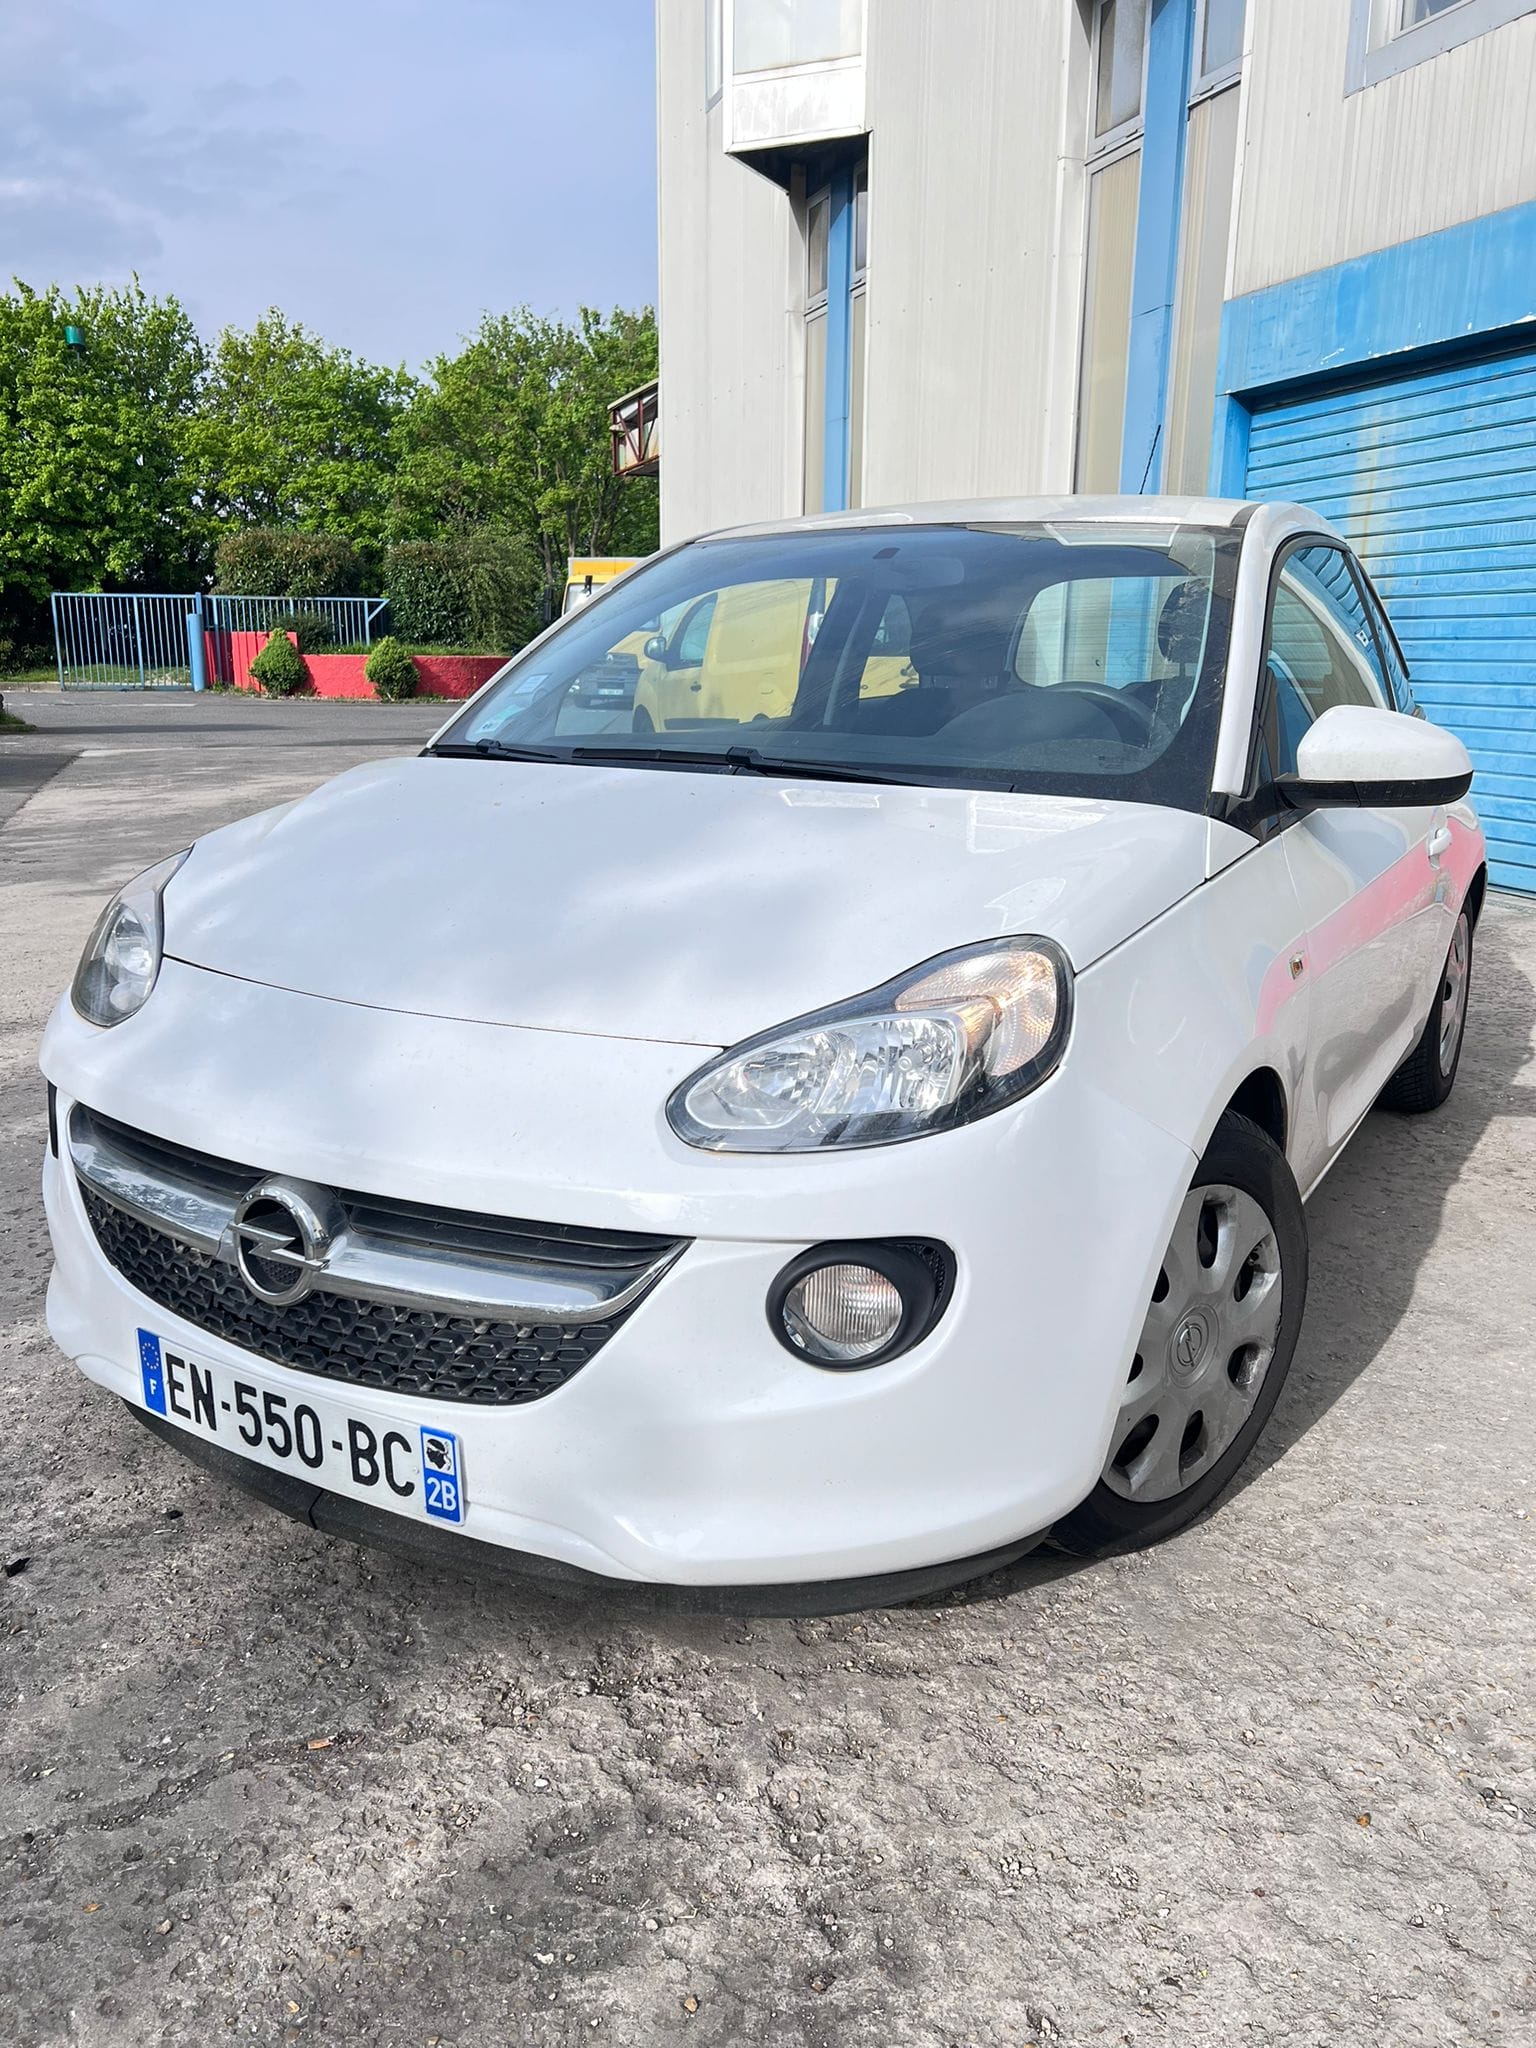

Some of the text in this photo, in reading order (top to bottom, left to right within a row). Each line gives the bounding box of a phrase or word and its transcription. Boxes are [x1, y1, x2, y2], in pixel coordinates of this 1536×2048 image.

[149, 1378, 157, 1396] F
[165, 1352, 416, 1498] EN-550-BC
[426, 1476, 457, 1512] 2B
